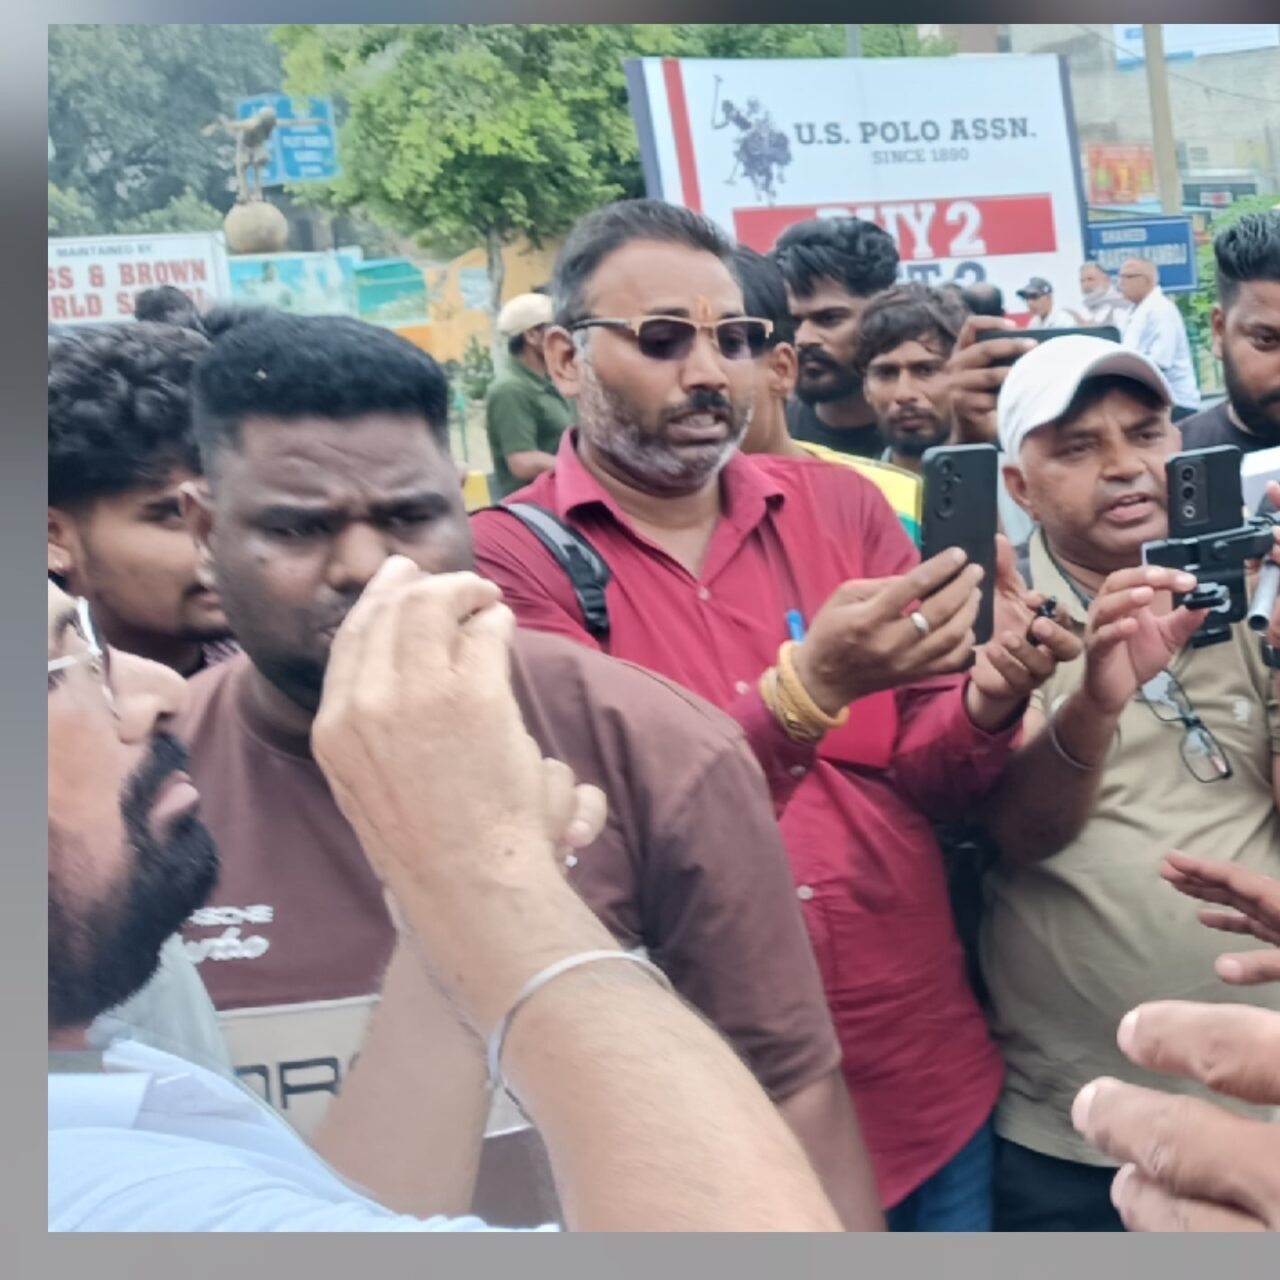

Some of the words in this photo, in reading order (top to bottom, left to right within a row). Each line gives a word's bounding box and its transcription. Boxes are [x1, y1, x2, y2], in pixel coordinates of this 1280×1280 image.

[794, 122, 850, 145] U.S.
[858, 120, 941, 145] POLO
[950, 117, 1037, 142] ASSN.
[872, 149, 926, 166] SINCE
[931, 147, 970, 164] 1890
[945, 200, 987, 256] 2
[56, 244, 134, 257] MAINTAINED
[48, 265, 74, 290] SS
[118, 258, 207, 286] BROWN
[50, 293, 103, 319] RLD
